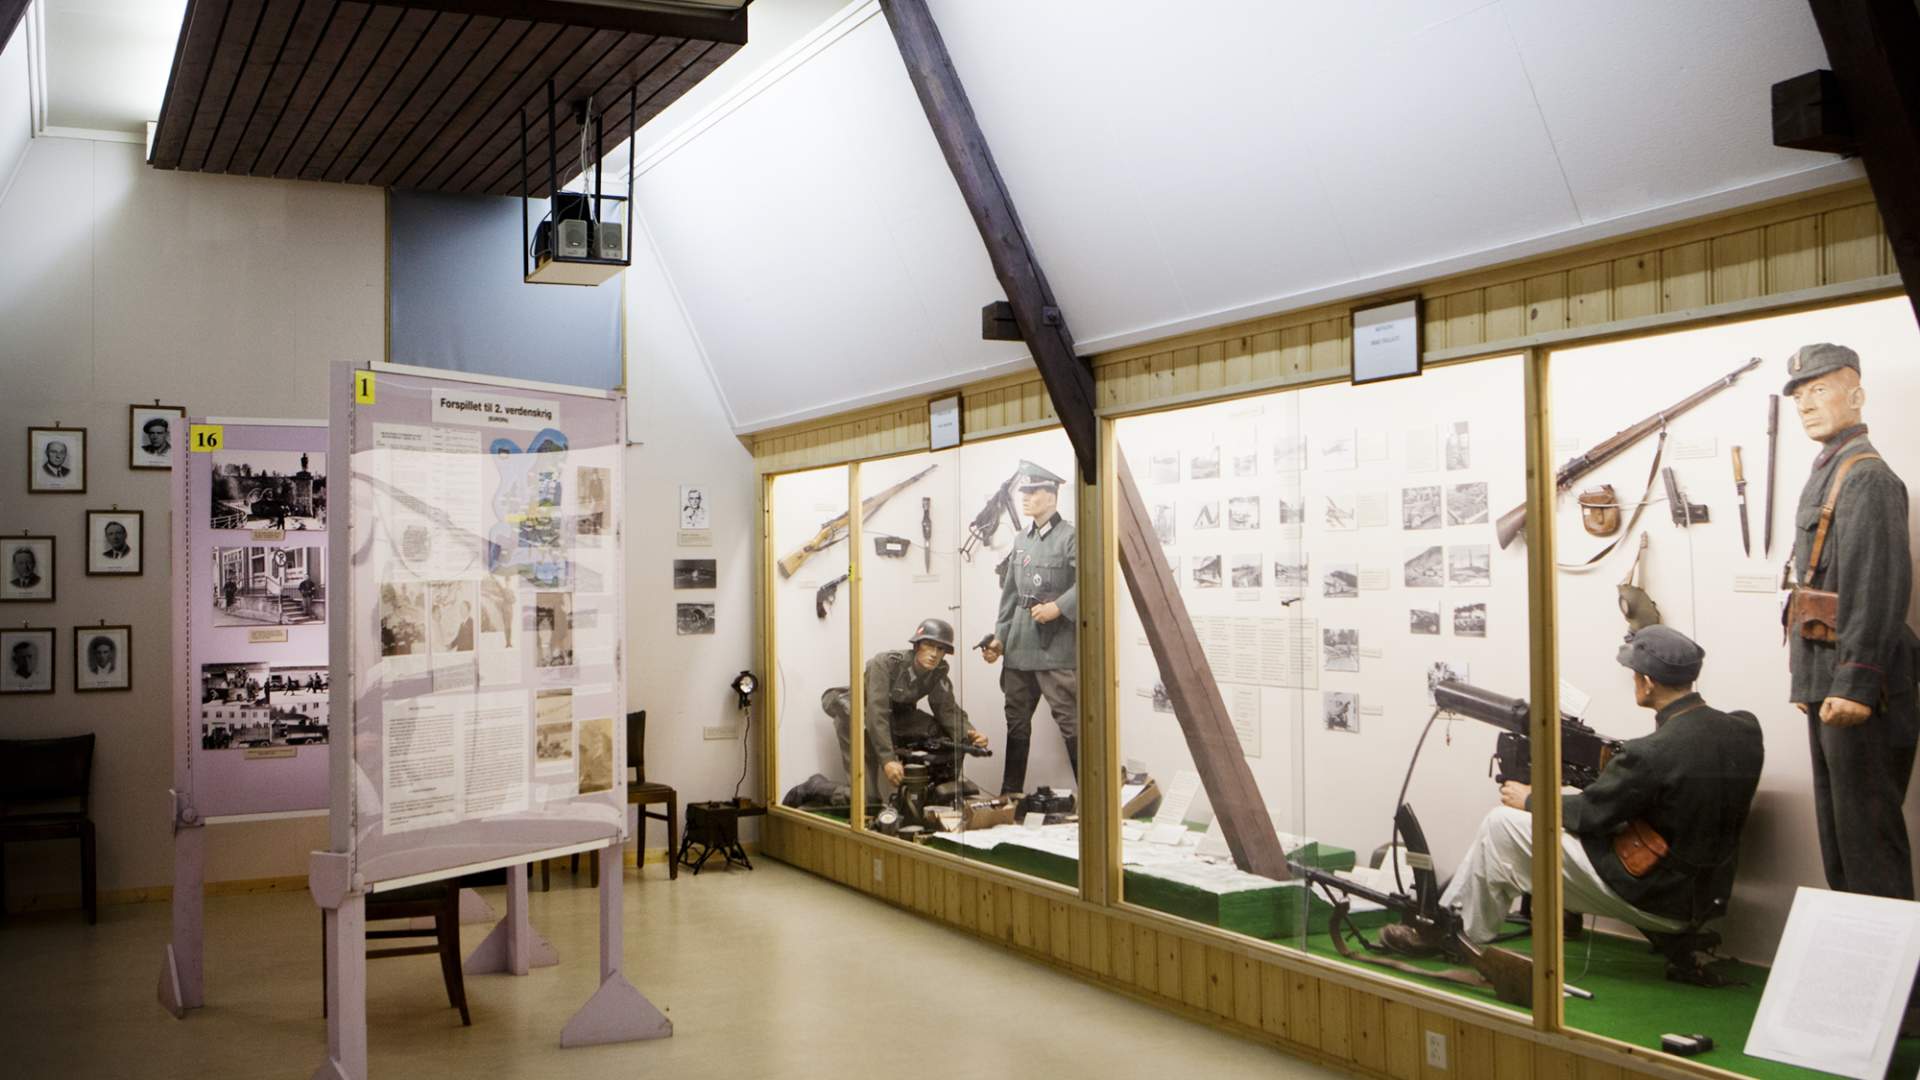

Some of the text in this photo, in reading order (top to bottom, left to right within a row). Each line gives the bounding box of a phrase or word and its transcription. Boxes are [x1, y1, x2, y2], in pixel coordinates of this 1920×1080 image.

[360, 378, 368, 397] 1
[440, 398, 552, 420] Forspillet til 2. verdenskrig
[197, 432, 217, 447] 16
